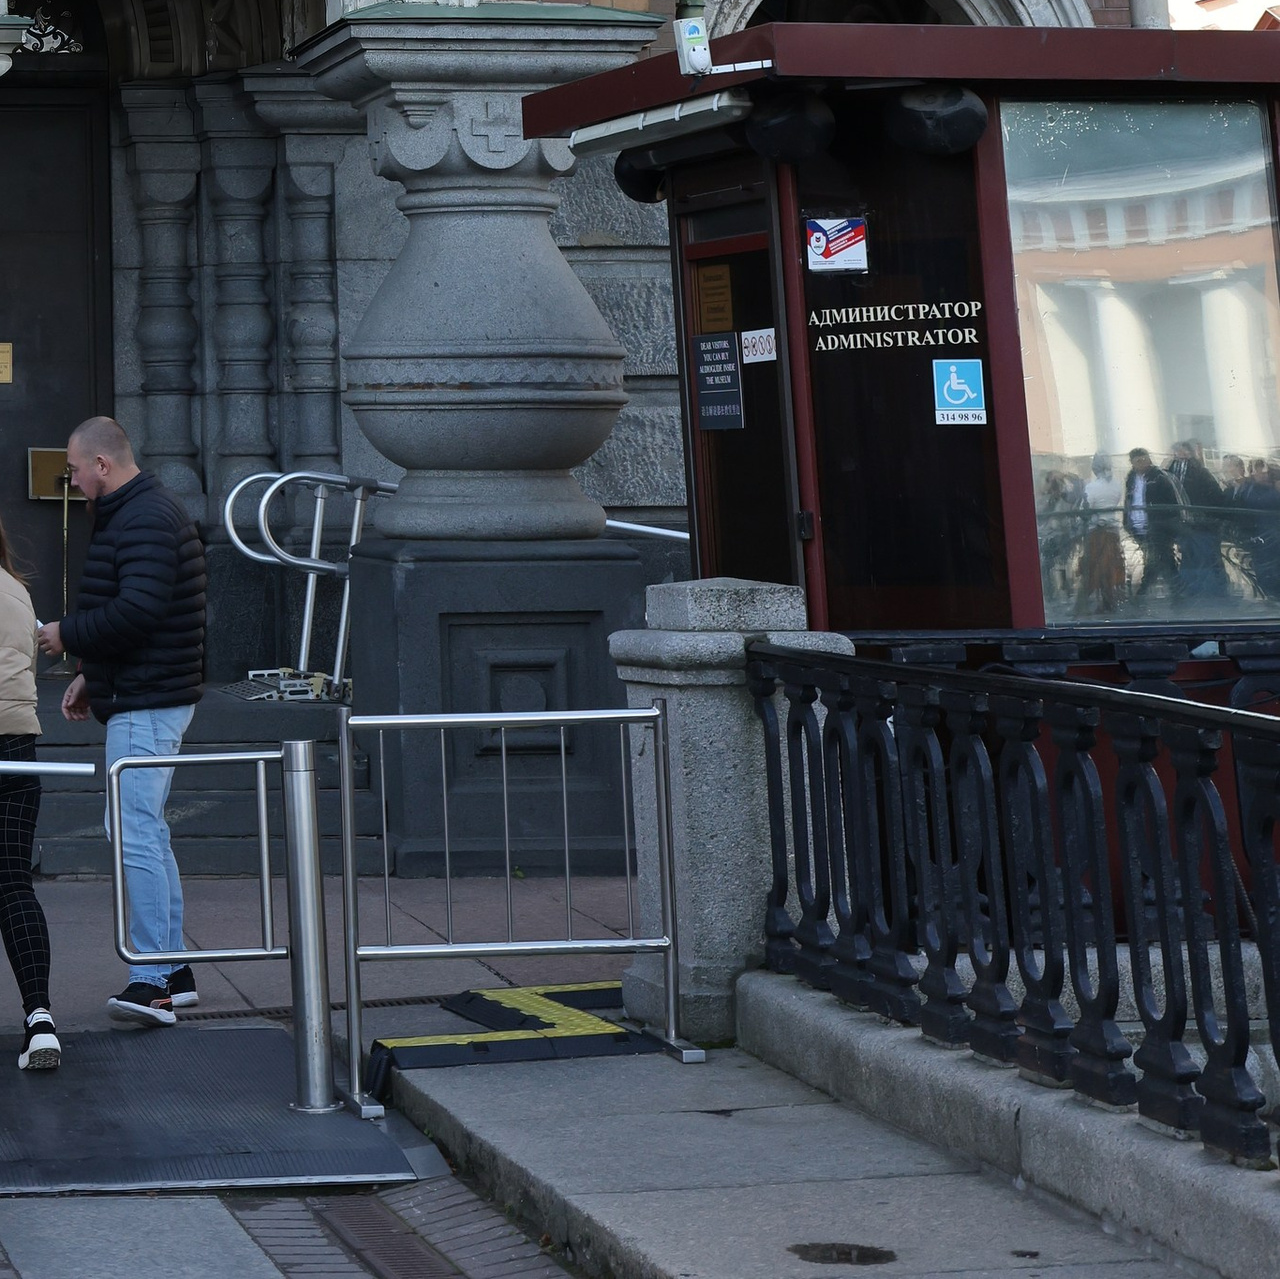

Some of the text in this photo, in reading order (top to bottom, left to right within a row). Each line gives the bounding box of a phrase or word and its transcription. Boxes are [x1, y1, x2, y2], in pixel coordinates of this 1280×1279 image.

[808, 301, 982, 328] АДМИНИСТРАТОР
[815, 328, 979, 351] ADMINISTRATOR
[700, 342, 712, 351] DEAR
[703, 352, 729, 362] YOU CAN BUY
[699, 363, 736, 373] AUDIOGUIDE INSIDE
[706, 375, 731, 385] THE MUSEUM
[940, 412, 983, 422] 314 98 96
